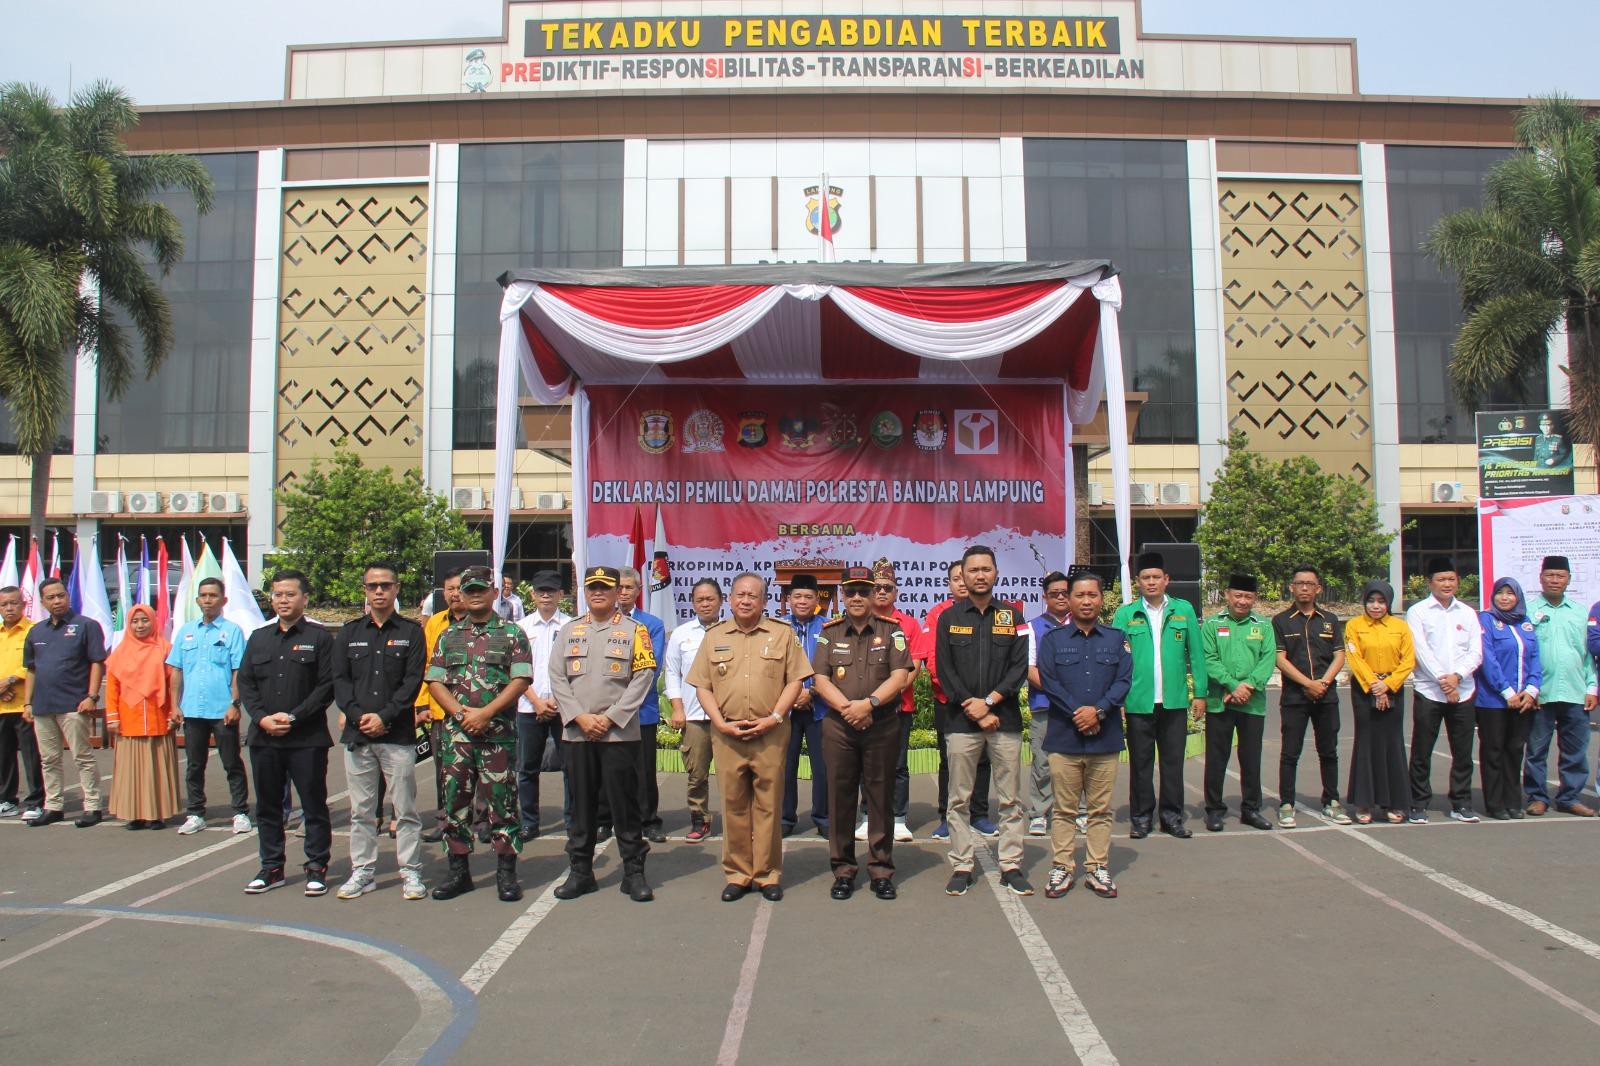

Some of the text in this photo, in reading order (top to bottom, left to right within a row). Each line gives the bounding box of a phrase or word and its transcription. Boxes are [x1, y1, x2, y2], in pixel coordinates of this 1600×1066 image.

[541, 19, 1107, 50] TEKADKU PENGABDIAN TERBAIK
[1483, 437, 1533, 447] PRESISI
[592, 480, 1044, 503] DEKLARASI PEMILU DAMAI POLRESTA BANDAR LAMPUNG
[778, 524, 856, 536] BERSAMA
